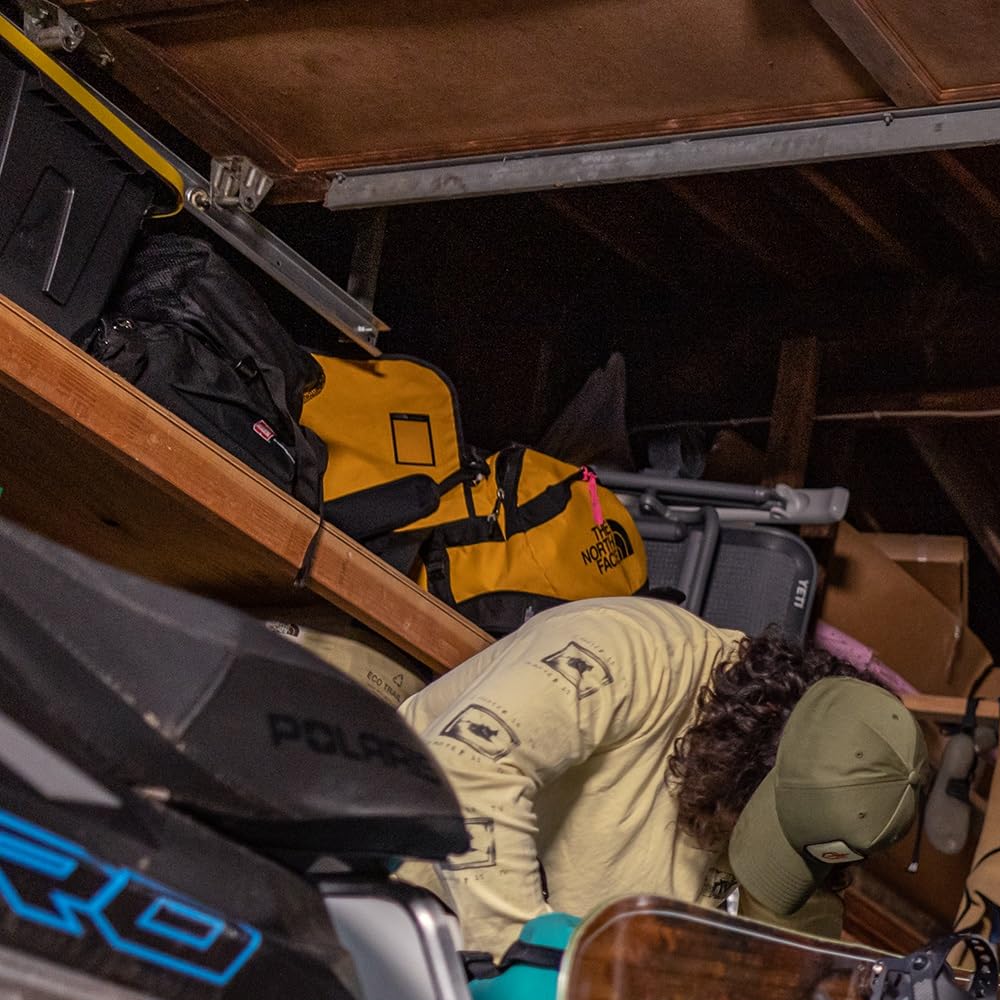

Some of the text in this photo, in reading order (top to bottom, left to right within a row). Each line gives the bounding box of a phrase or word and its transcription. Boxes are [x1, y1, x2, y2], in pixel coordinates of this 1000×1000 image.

[591, 520, 611, 542] THE
[581, 536, 617, 566] NORTH
[793, 580, 809, 609] YETI
[366, 671, 383, 687] ECO
